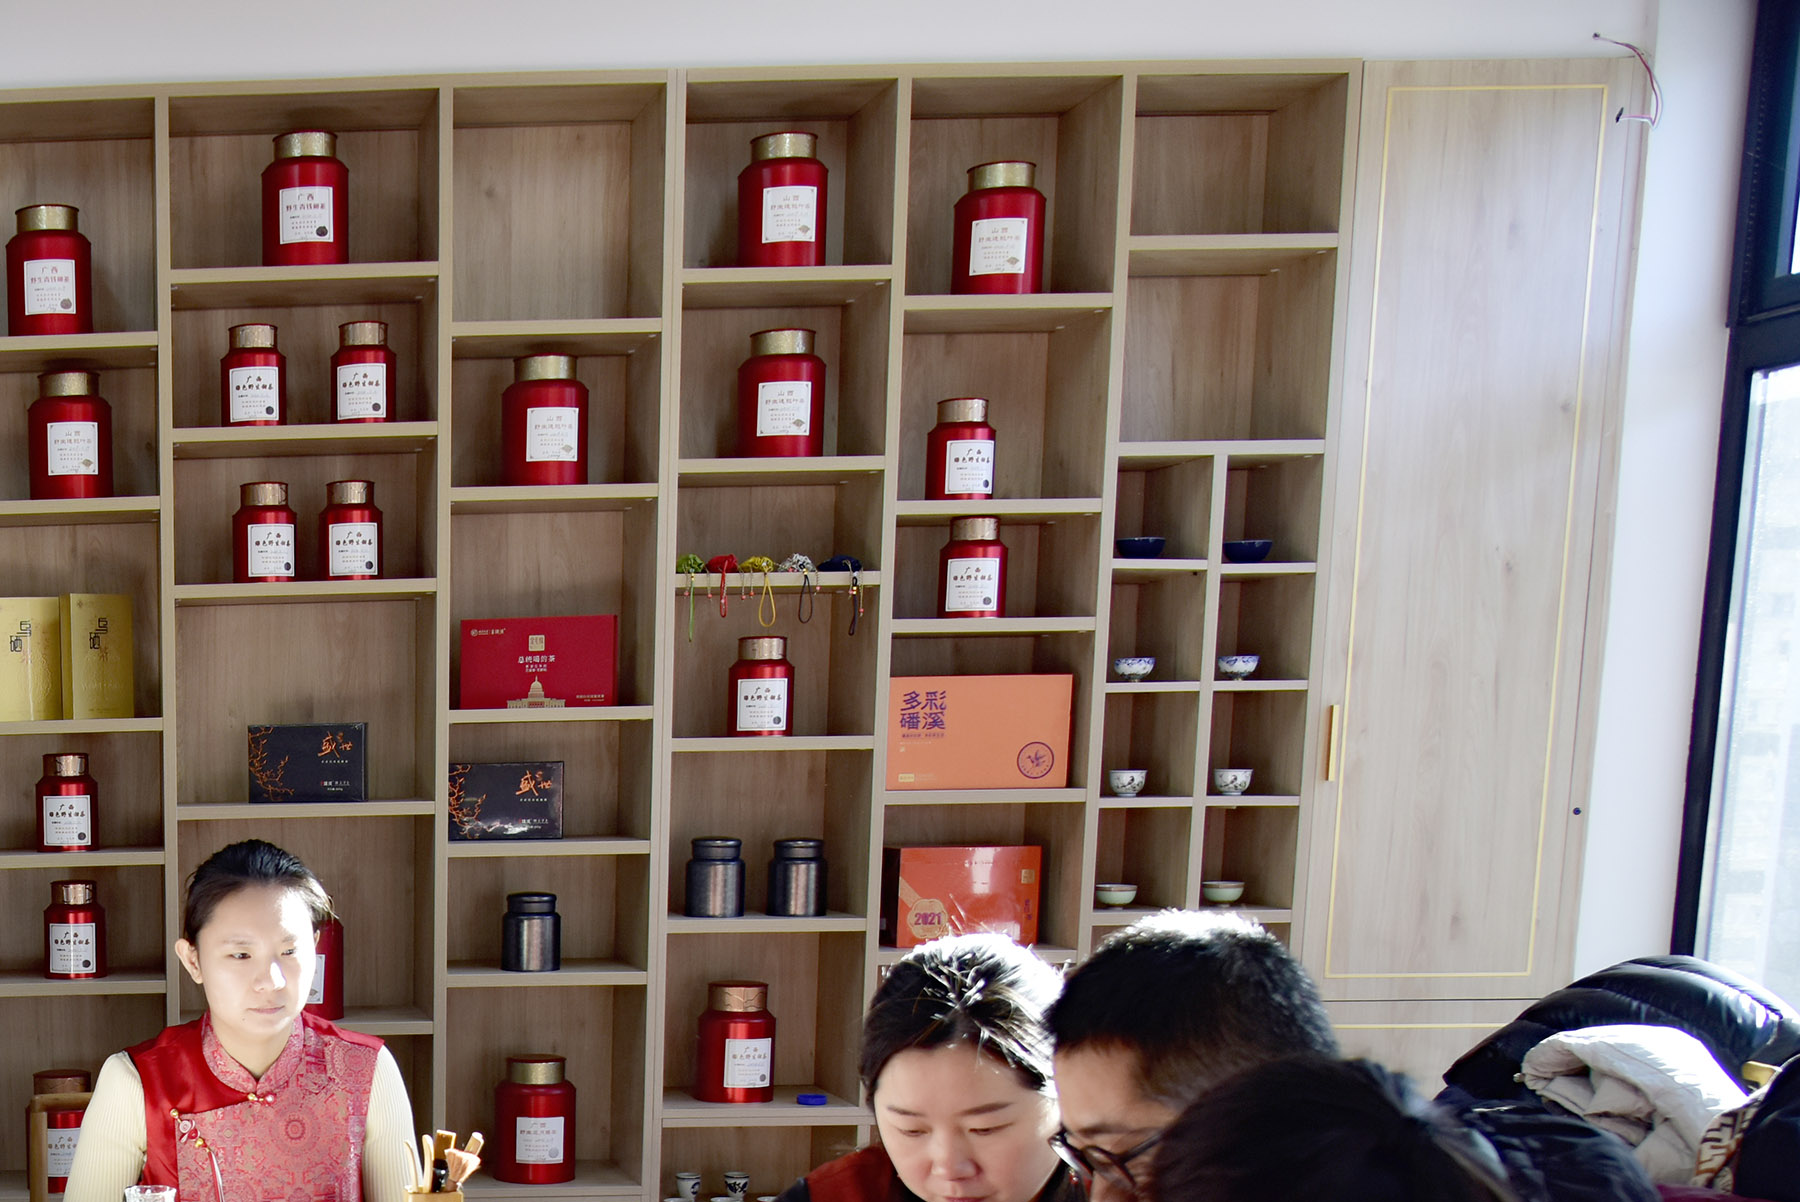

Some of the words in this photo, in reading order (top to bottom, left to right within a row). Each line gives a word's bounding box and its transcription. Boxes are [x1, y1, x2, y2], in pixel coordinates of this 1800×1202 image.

[900, 690, 947, 711] 多彩
[900, 712, 946, 730] 磻溪
[914, 912, 942, 926] 2021
